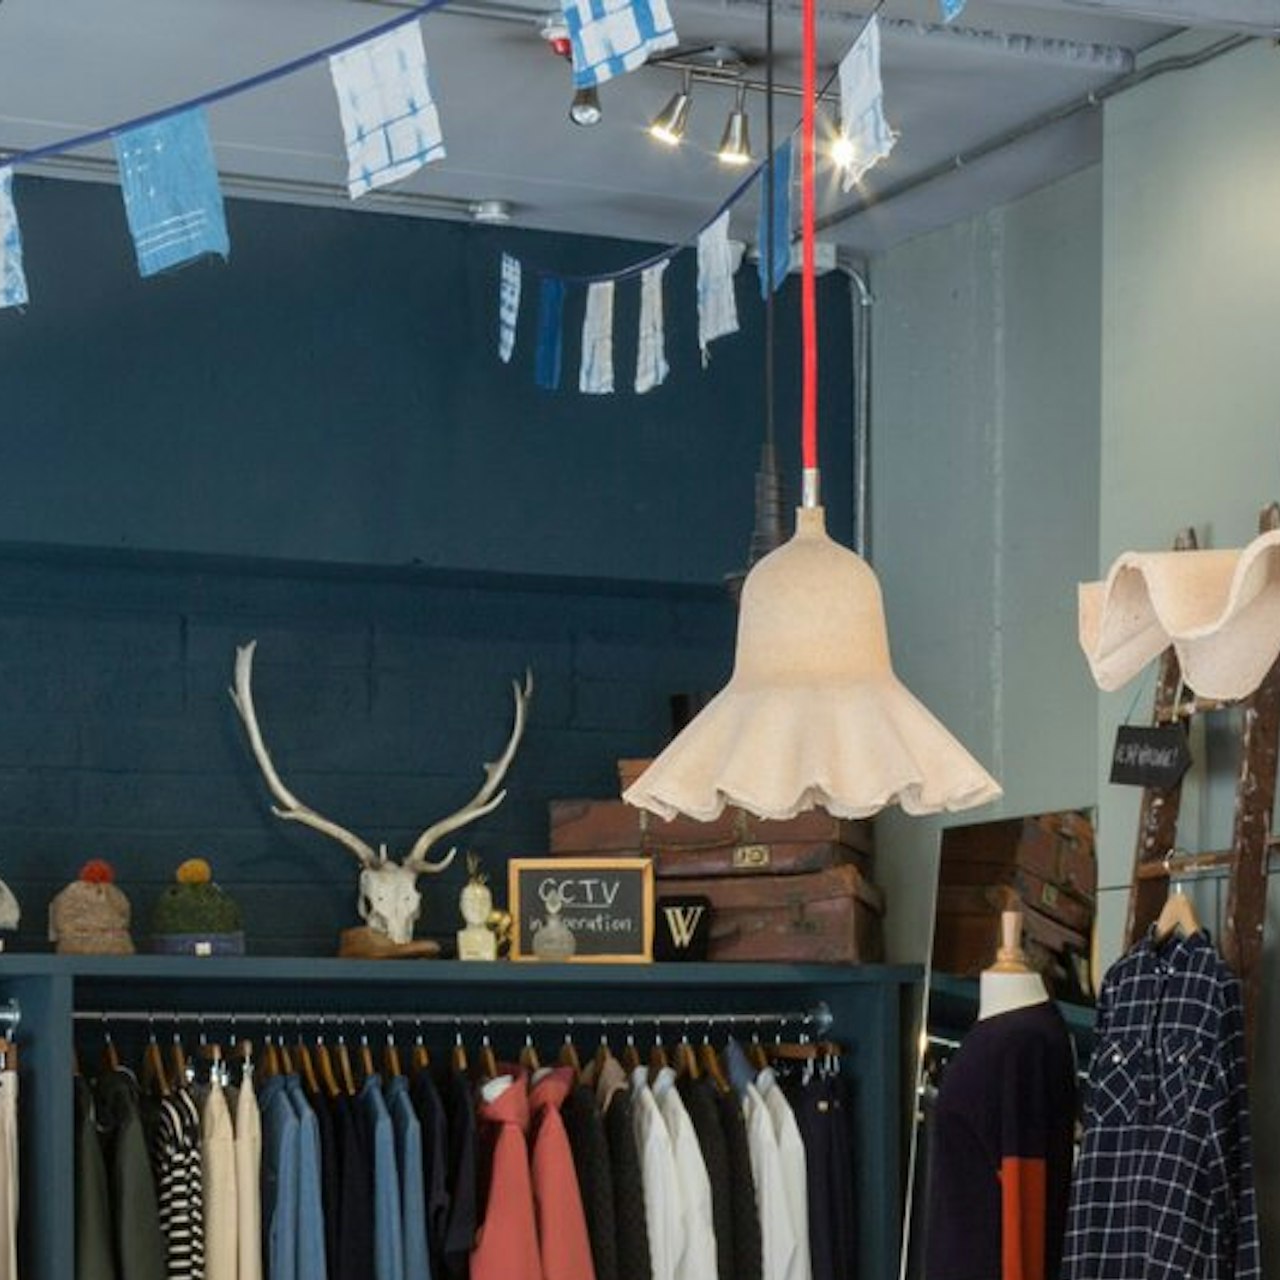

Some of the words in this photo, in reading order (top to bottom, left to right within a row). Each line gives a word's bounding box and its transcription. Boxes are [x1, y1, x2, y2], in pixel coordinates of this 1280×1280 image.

[539, 877, 620, 904] CCTV
[562, 913, 632, 933] eration
[665, 906, 705, 948] W
